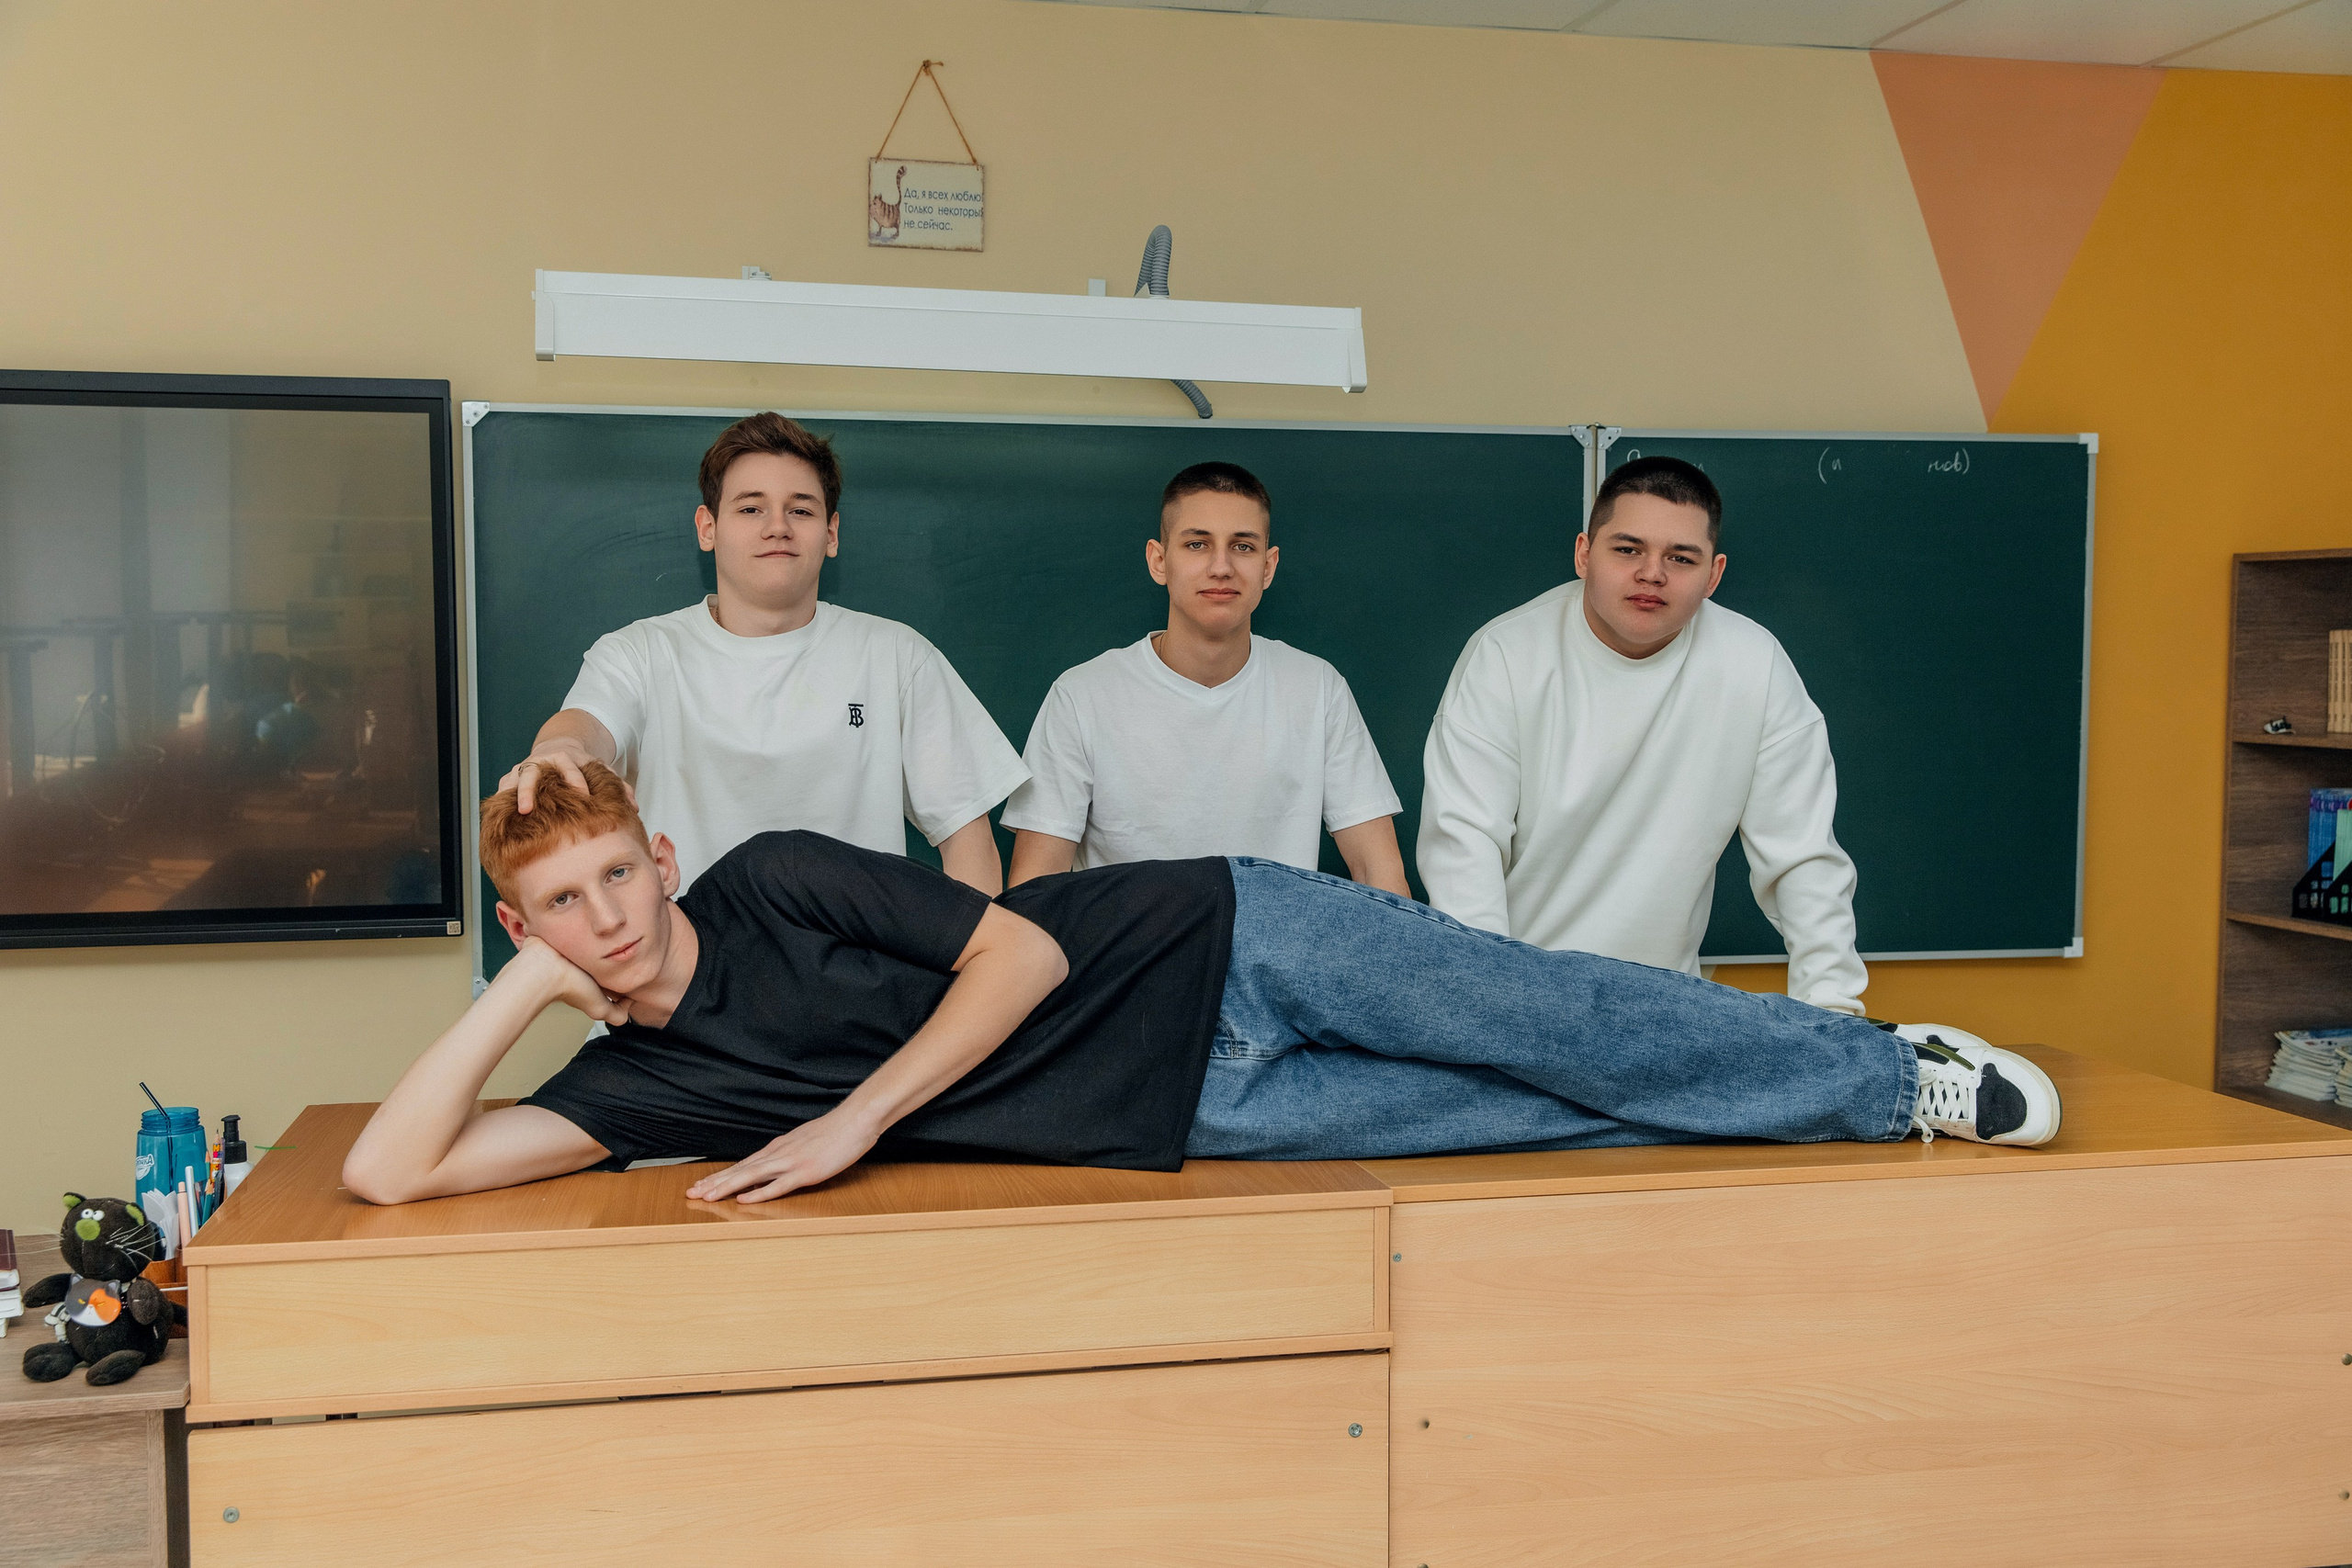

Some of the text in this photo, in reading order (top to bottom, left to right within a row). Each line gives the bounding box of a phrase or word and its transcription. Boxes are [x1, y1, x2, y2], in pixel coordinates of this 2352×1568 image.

[904, 187, 920, 199] Да,
[922, 190, 926, 198] я
[928, 190, 948, 200] всех
[904, 202, 933, 214] Только
[903, 219, 953, 231] не сейчас.
